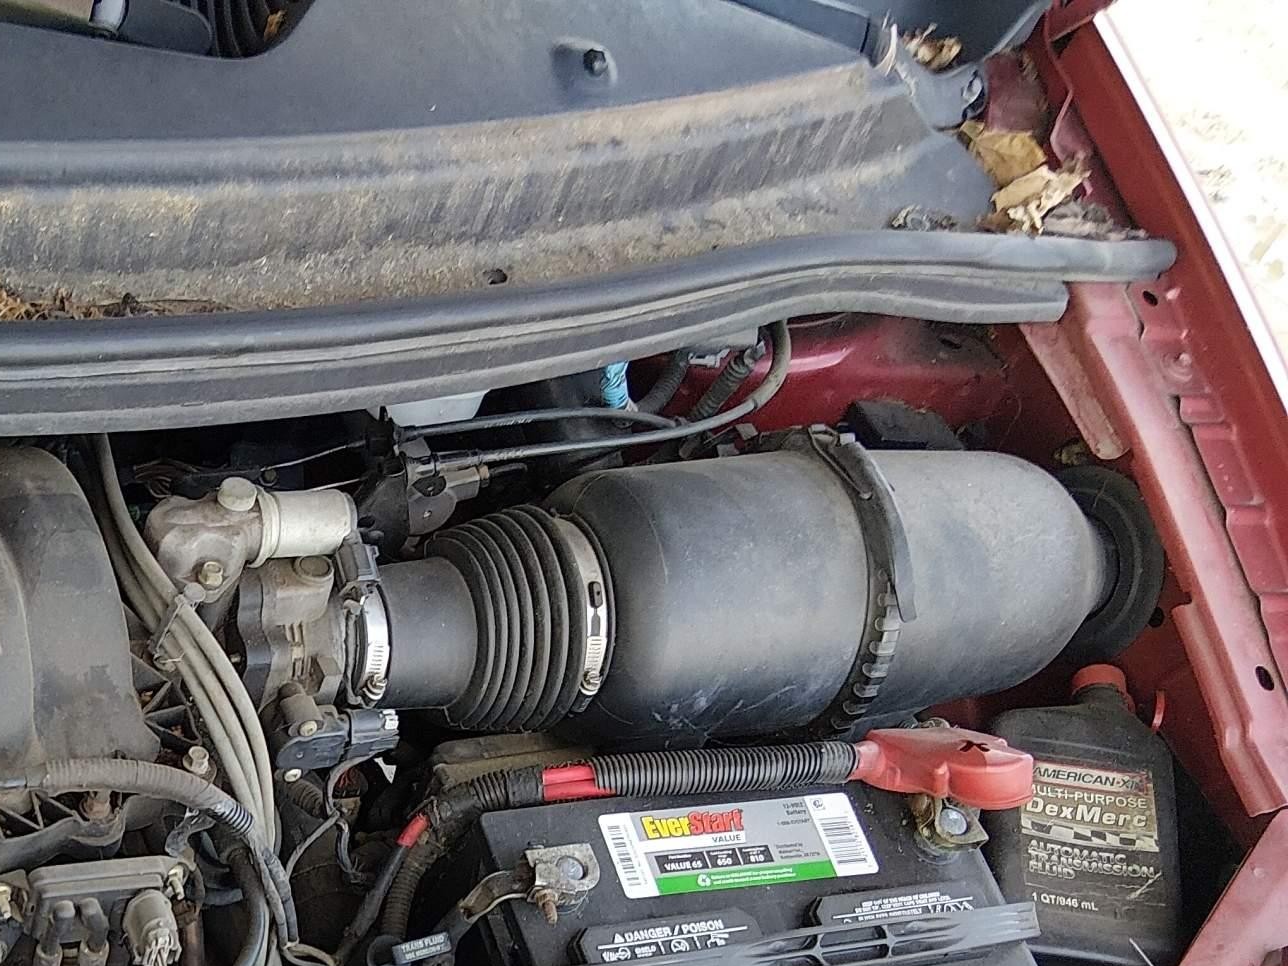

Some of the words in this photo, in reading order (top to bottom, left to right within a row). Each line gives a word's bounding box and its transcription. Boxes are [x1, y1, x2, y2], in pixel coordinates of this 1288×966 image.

[1026, 797, 1147, 827] DexMerc
[640, 808, 743, 840] EverStart
[712, 834, 742, 843] VALUE
[1028, 839, 1127, 864] AUTOMATIC
[664, 860, 691, 872] VALUE
[691, 859, 703, 869] 65
[717, 857, 733, 866] 650
[1029, 850, 1155, 878] TRANSMISSION
[1029, 861, 1075, 880] FLUID
[1032, 892, 1038, 901] 1
[1041, 893, 1079, 908] QT/946
[1081, 901, 1099, 911] mL
[624, 926, 672, 942] DANGER
[682, 919, 724, 934] POISON
[401, 940, 424, 953] TRANS
[424, 935, 445, 947] FLUID
